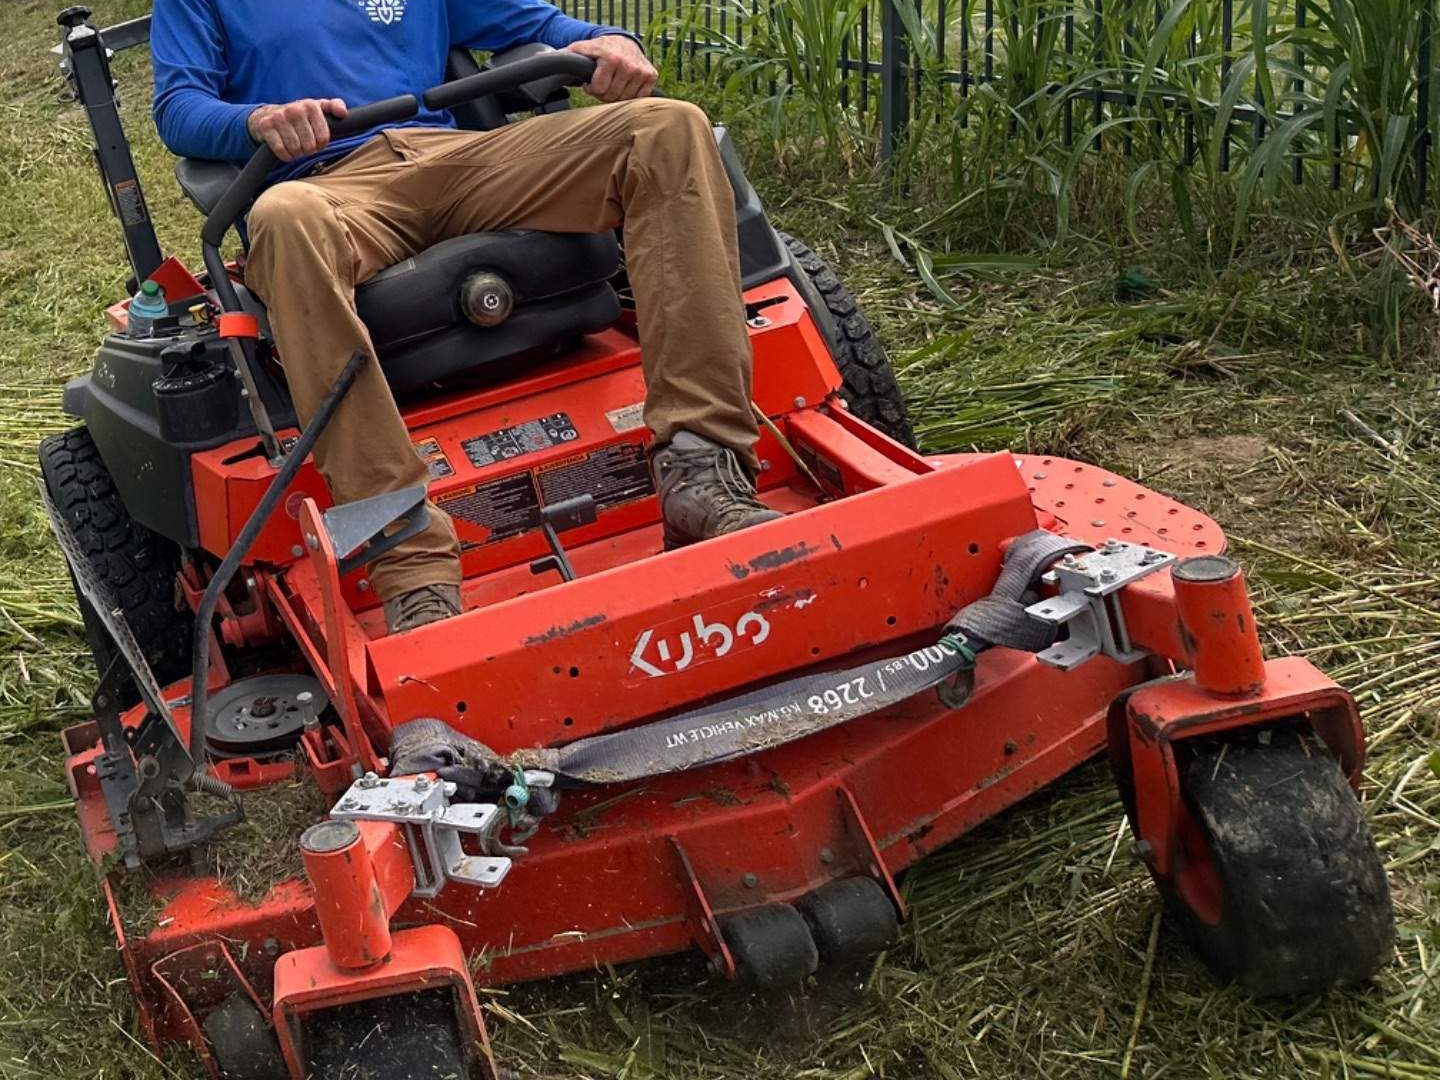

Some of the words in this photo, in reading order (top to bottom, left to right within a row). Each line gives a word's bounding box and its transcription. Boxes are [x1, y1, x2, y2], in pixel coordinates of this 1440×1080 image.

[629, 610, 771, 677] Kubo
[807, 677, 874, 714] 2268
[665, 732, 689, 748] WT
[688, 721, 743, 742] VEHICLE
